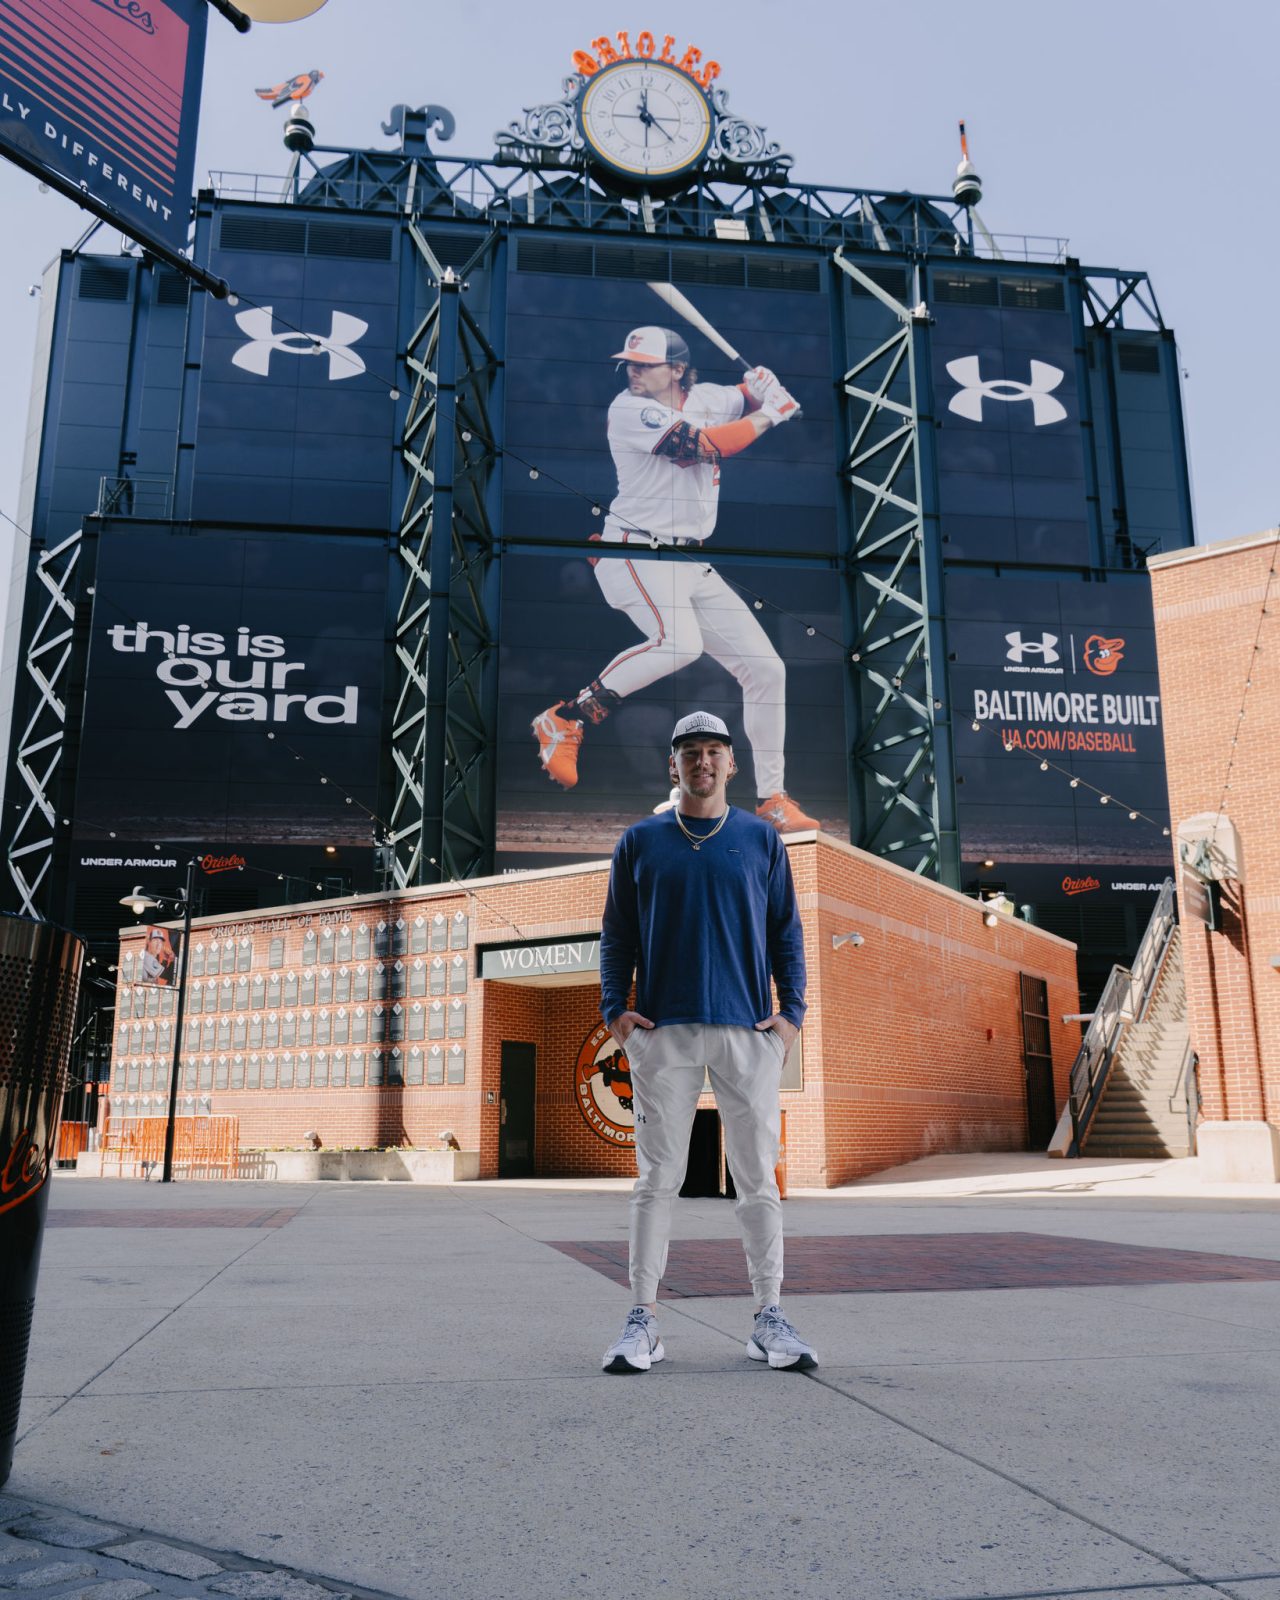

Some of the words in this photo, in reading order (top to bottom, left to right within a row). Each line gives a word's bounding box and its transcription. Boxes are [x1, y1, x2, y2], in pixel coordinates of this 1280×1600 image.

[572, 31, 721, 88] ORIOLES
[603, 89, 616, 102] 10
[641, 76, 654, 87] 12
[44, 121, 172, 221] DIFFERENT
[107, 622, 226, 656] this
[237, 626, 286, 658] is
[156, 657, 305, 689] our
[164, 685, 359, 729] yard
[974, 689, 1099, 724] BALTIMORE
[1102, 693, 1160, 726] BUILT
[1002, 728, 1137, 753] UA.COM/BASEBALL
[81, 857, 123, 867] UNDER
[124, 858, 177, 868] ARMOUR
[201, 853, 246, 874] Orioles
[1062, 876, 1100, 896] Orioles
[1111, 882, 1147, 890] UNDER
[209, 922, 256, 940] ORIOLES
[260, 918, 291, 934] HALL
[296, 914, 312, 928] OF
[319, 910, 353, 927] FAME
[499, 943, 584, 970] WOMEN
[579, 1083, 637, 1142] BALTIMOR
